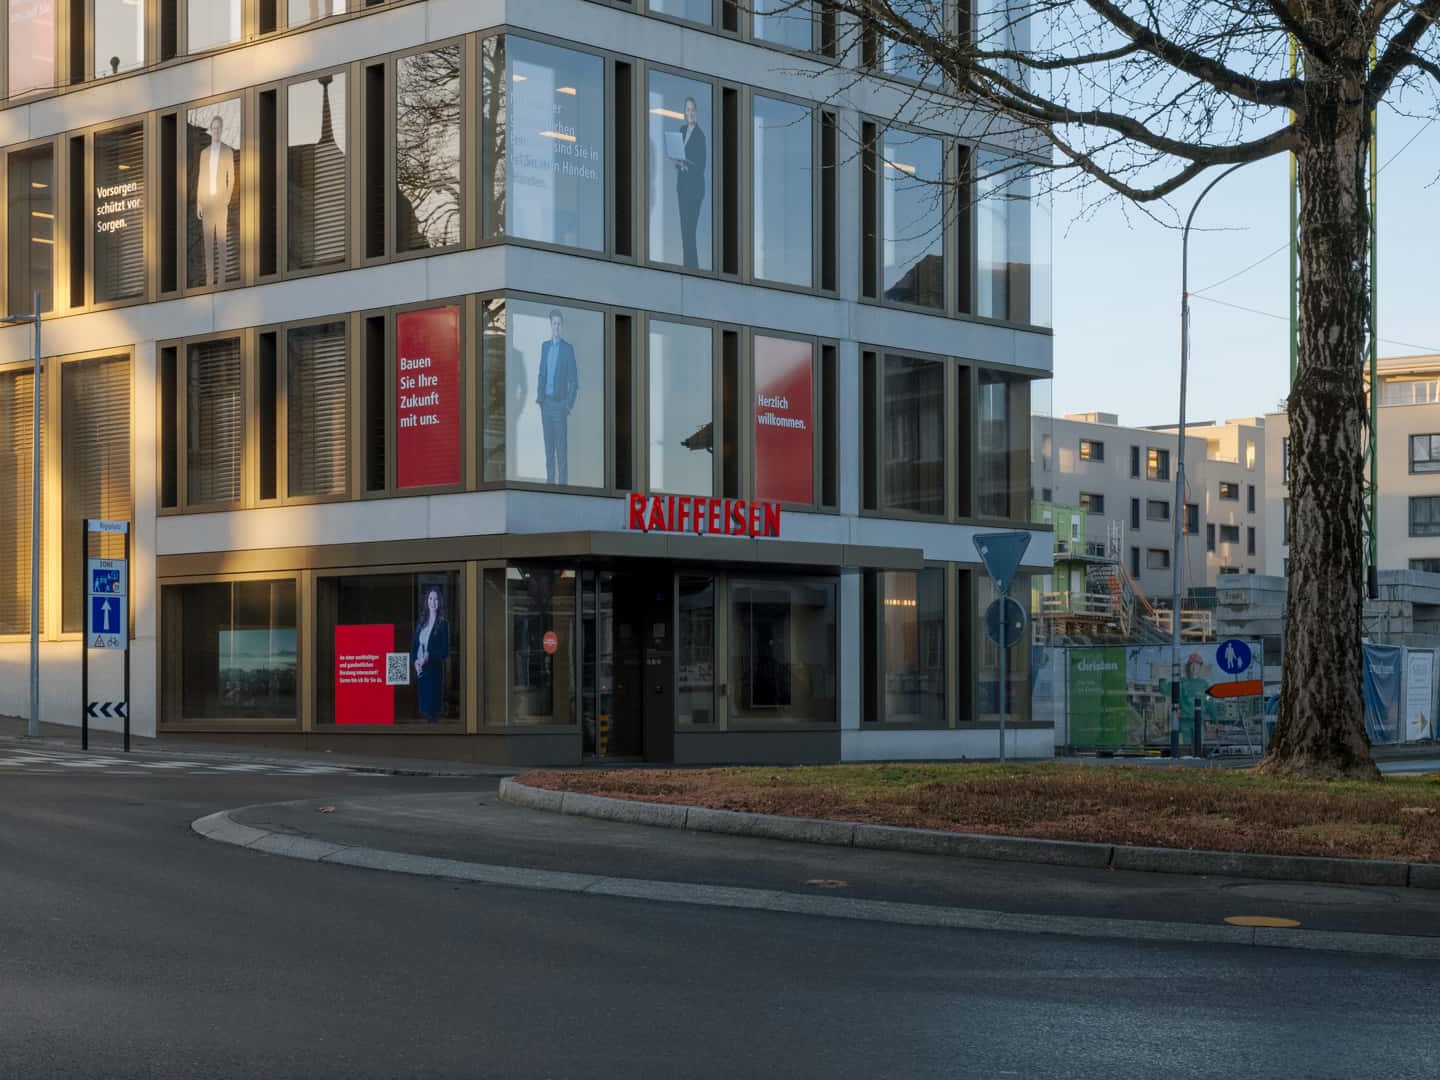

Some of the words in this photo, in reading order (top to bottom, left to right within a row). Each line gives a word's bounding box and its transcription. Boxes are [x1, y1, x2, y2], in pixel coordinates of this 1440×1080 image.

[97, 181, 137, 199] Vorsorgen
[97, 199, 126, 216] schützt
[127, 197, 141, 209] vor
[97, 218, 127, 233] Sorgen.
[400, 357, 431, 370] Bauen
[400, 376, 415, 390] Sie
[418, 373, 438, 387] Ihre
[400, 392, 439, 409] Zukunft
[758, 395, 788, 409] Herzlich
[400, 414, 417, 428] mit
[420, 414, 440, 426] uns.
[758, 413, 806, 429] willkommen.
[629, 493, 781, 537] RAIFFEISEN
